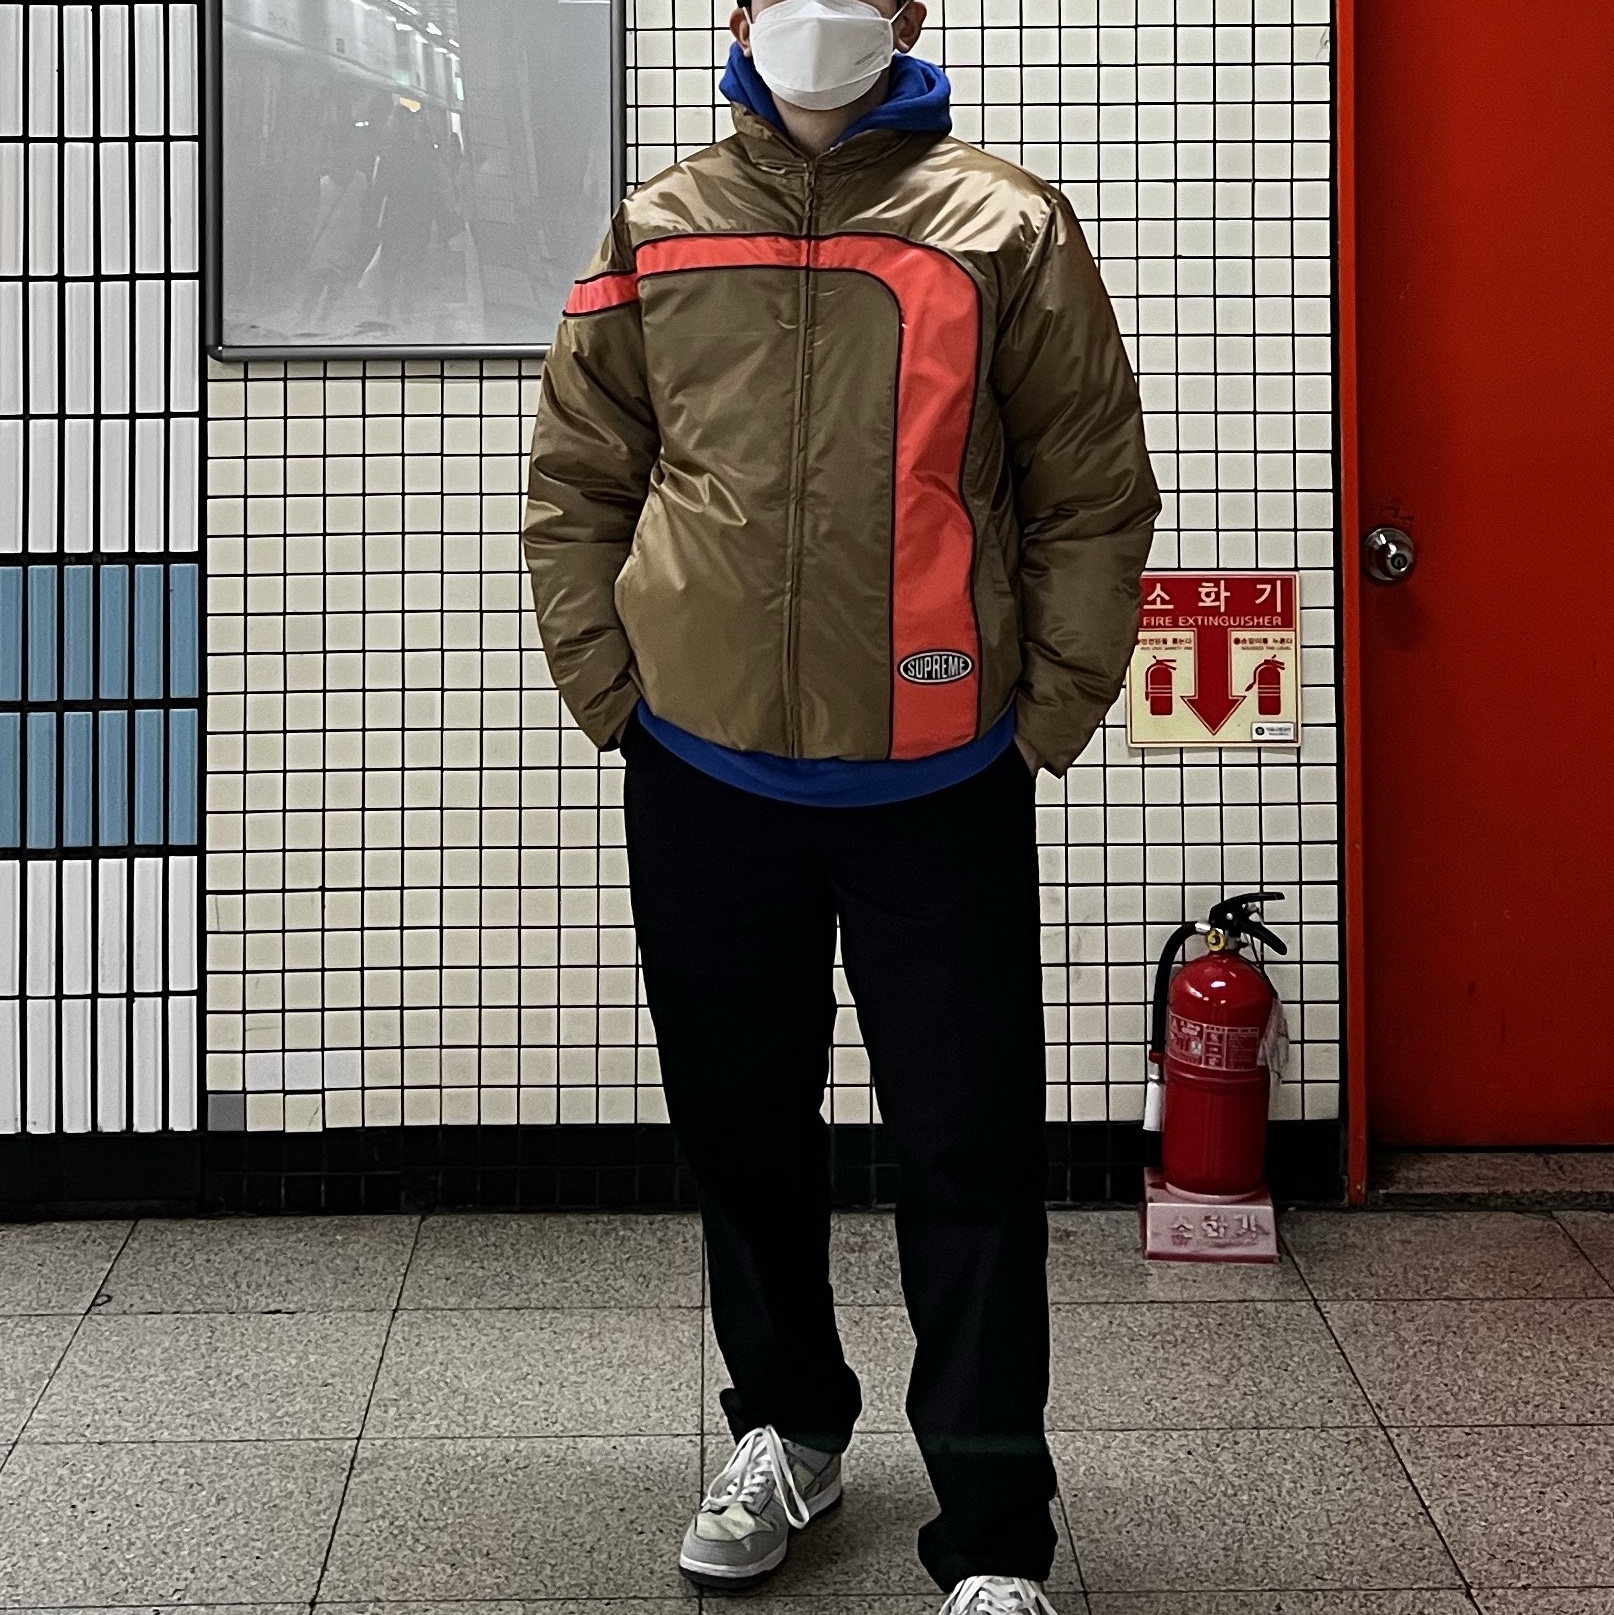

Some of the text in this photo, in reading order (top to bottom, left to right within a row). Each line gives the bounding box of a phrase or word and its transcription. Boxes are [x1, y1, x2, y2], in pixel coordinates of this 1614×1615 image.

[1142, 615, 1283, 627] FIRE EXTINGUISHER
[907, 655, 967, 679] SUPREME
